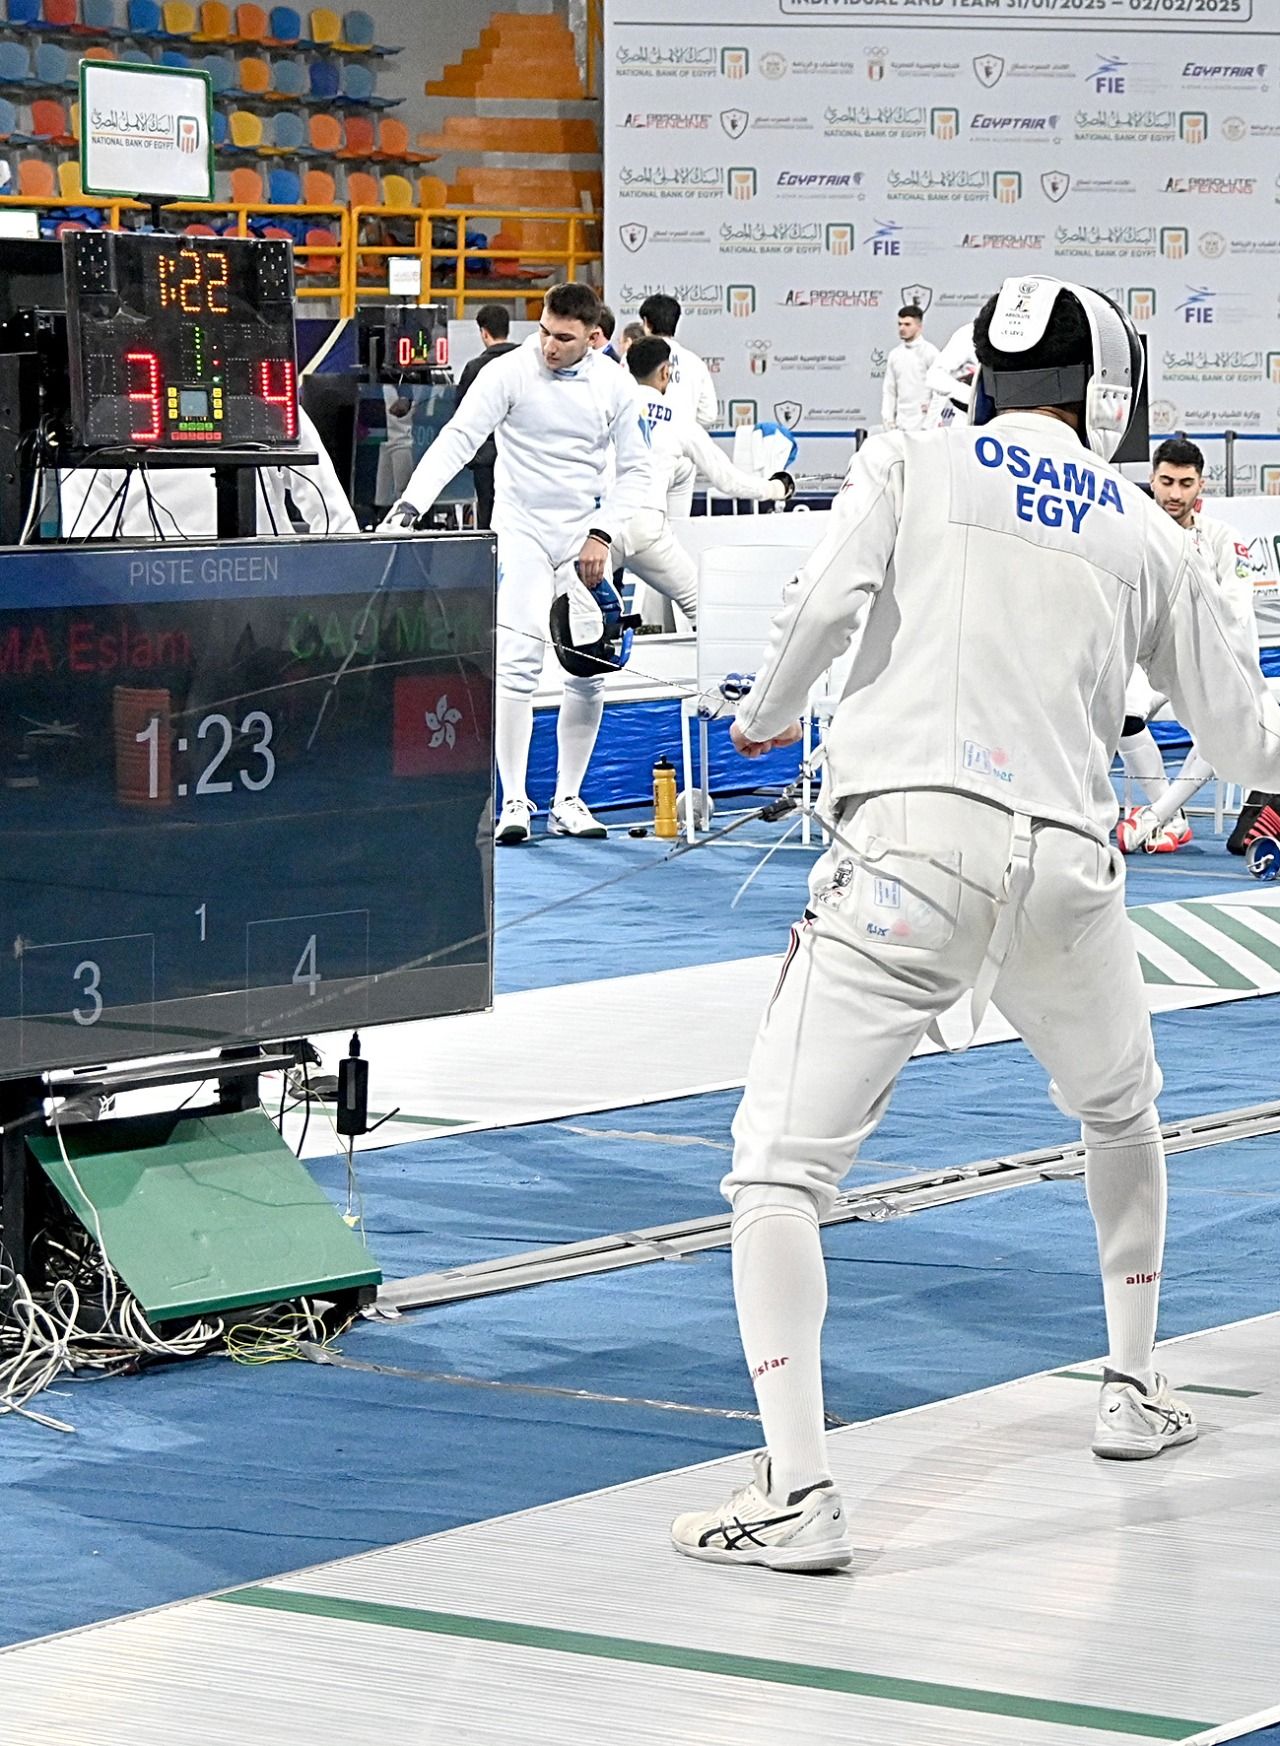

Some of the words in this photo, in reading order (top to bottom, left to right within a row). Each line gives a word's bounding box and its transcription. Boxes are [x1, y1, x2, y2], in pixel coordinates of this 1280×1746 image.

[679, 70, 690, 78] OF
[692, 70, 717, 78] EGYPT
[1182, 62, 1254, 77] EGYPTAIR
[1096, 77, 1125, 94] FIE
[970, 114, 1047, 129] EGYPTAIR
[91, 137, 124, 147] NATIONAL
[125, 139, 142, 148] BANK
[144, 140, 152, 148] OF
[154, 141, 174, 150] EGYPT
[777, 171, 851, 186] EGYPTAIR
[684, 191, 696, 199] OF
[698, 191, 724, 199] EGYPT
[873, 240, 901, 256] FIE
[810, 290, 878, 298] ABSOLUTE
[1185, 307, 1213, 323] FIE
[127, 352, 160, 440] 3
[261, 359, 292, 438] 4
[974, 436, 1125, 515] OSAMA
[1016, 484, 1092, 534] EGY
[130, 559, 194, 587] PISTE
[201, 556, 278, 584] GREEN
[69, 621, 192, 673] Eslam
[289, 605, 380, 659] CAO
[136, 710, 276, 799] 1:23
[194, 903, 207, 942] 1
[292, 934, 322, 996] 4
[72, 960, 104, 1026] 3
